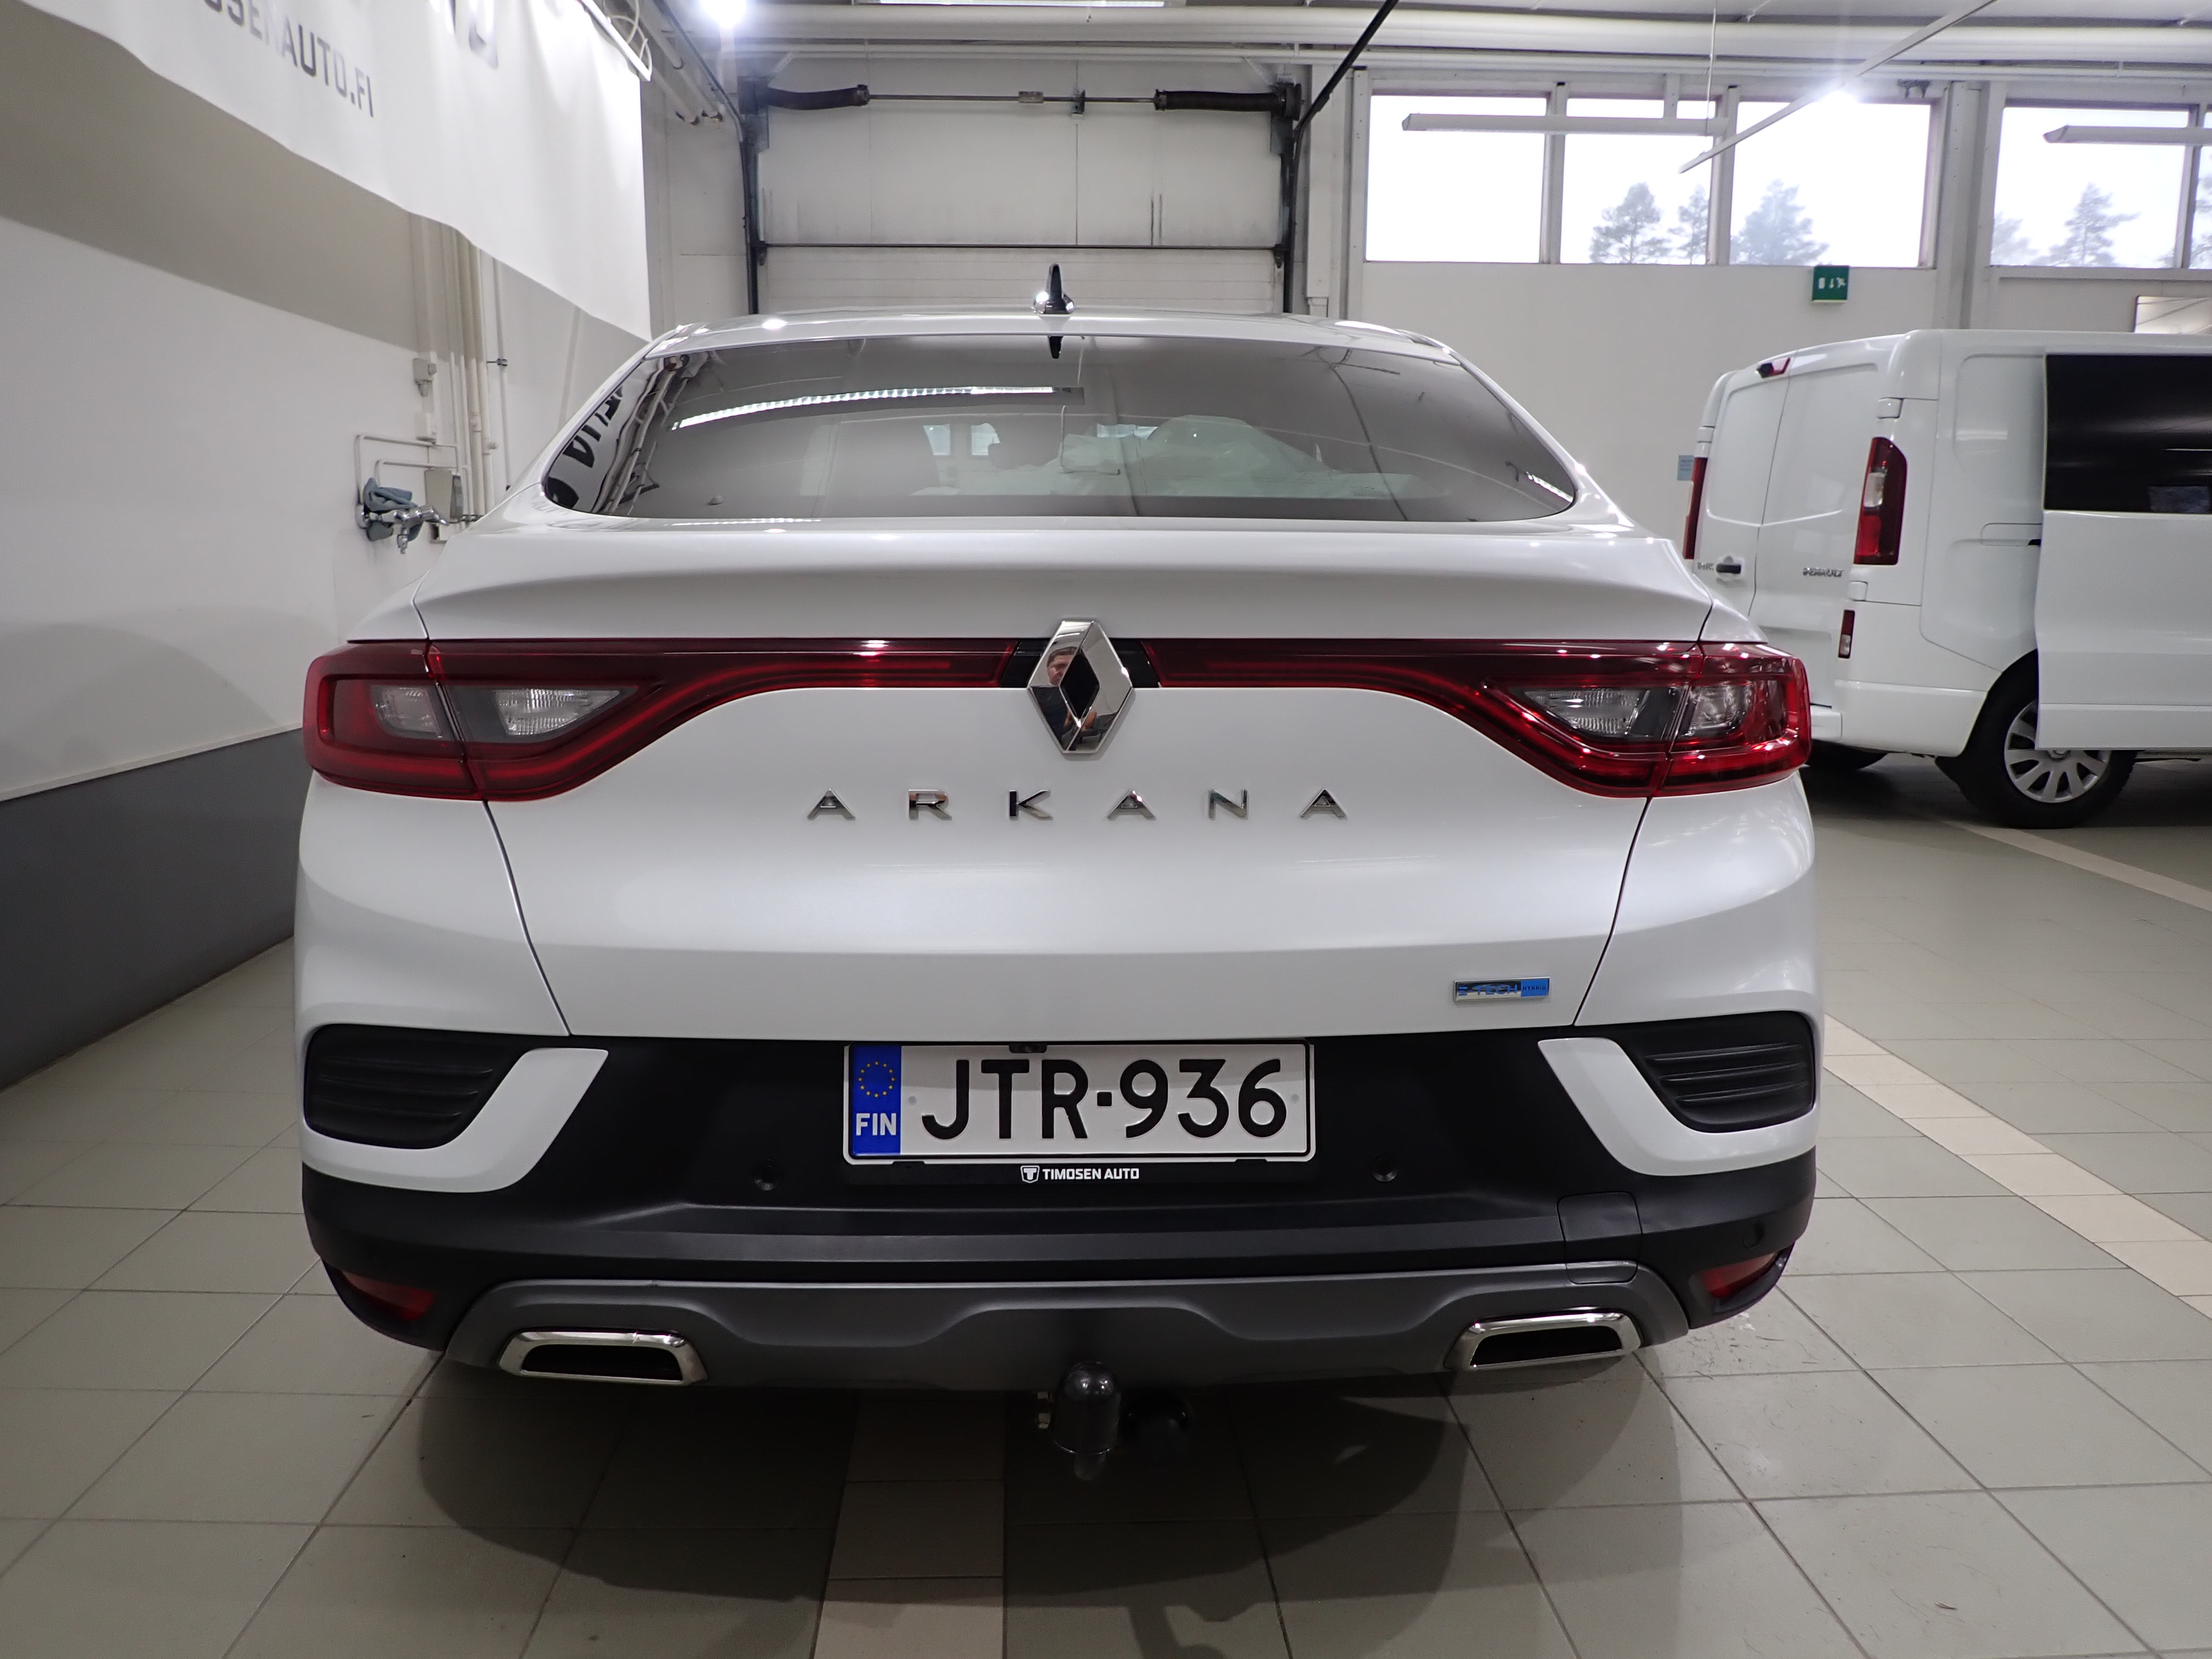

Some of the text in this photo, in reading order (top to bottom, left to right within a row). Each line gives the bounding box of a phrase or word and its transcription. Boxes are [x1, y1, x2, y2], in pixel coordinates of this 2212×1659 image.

[806, 788, 1347, 821] ARKANA
[1458, 984, 1518, 996] E-TECH
[922, 1058, 1287, 1139] JTR-936
[855, 1112, 897, 1136] FIN
[1042, 1168, 1102, 1180] TIMOSEN
[1104, 1168, 1140, 1180] AUTO
